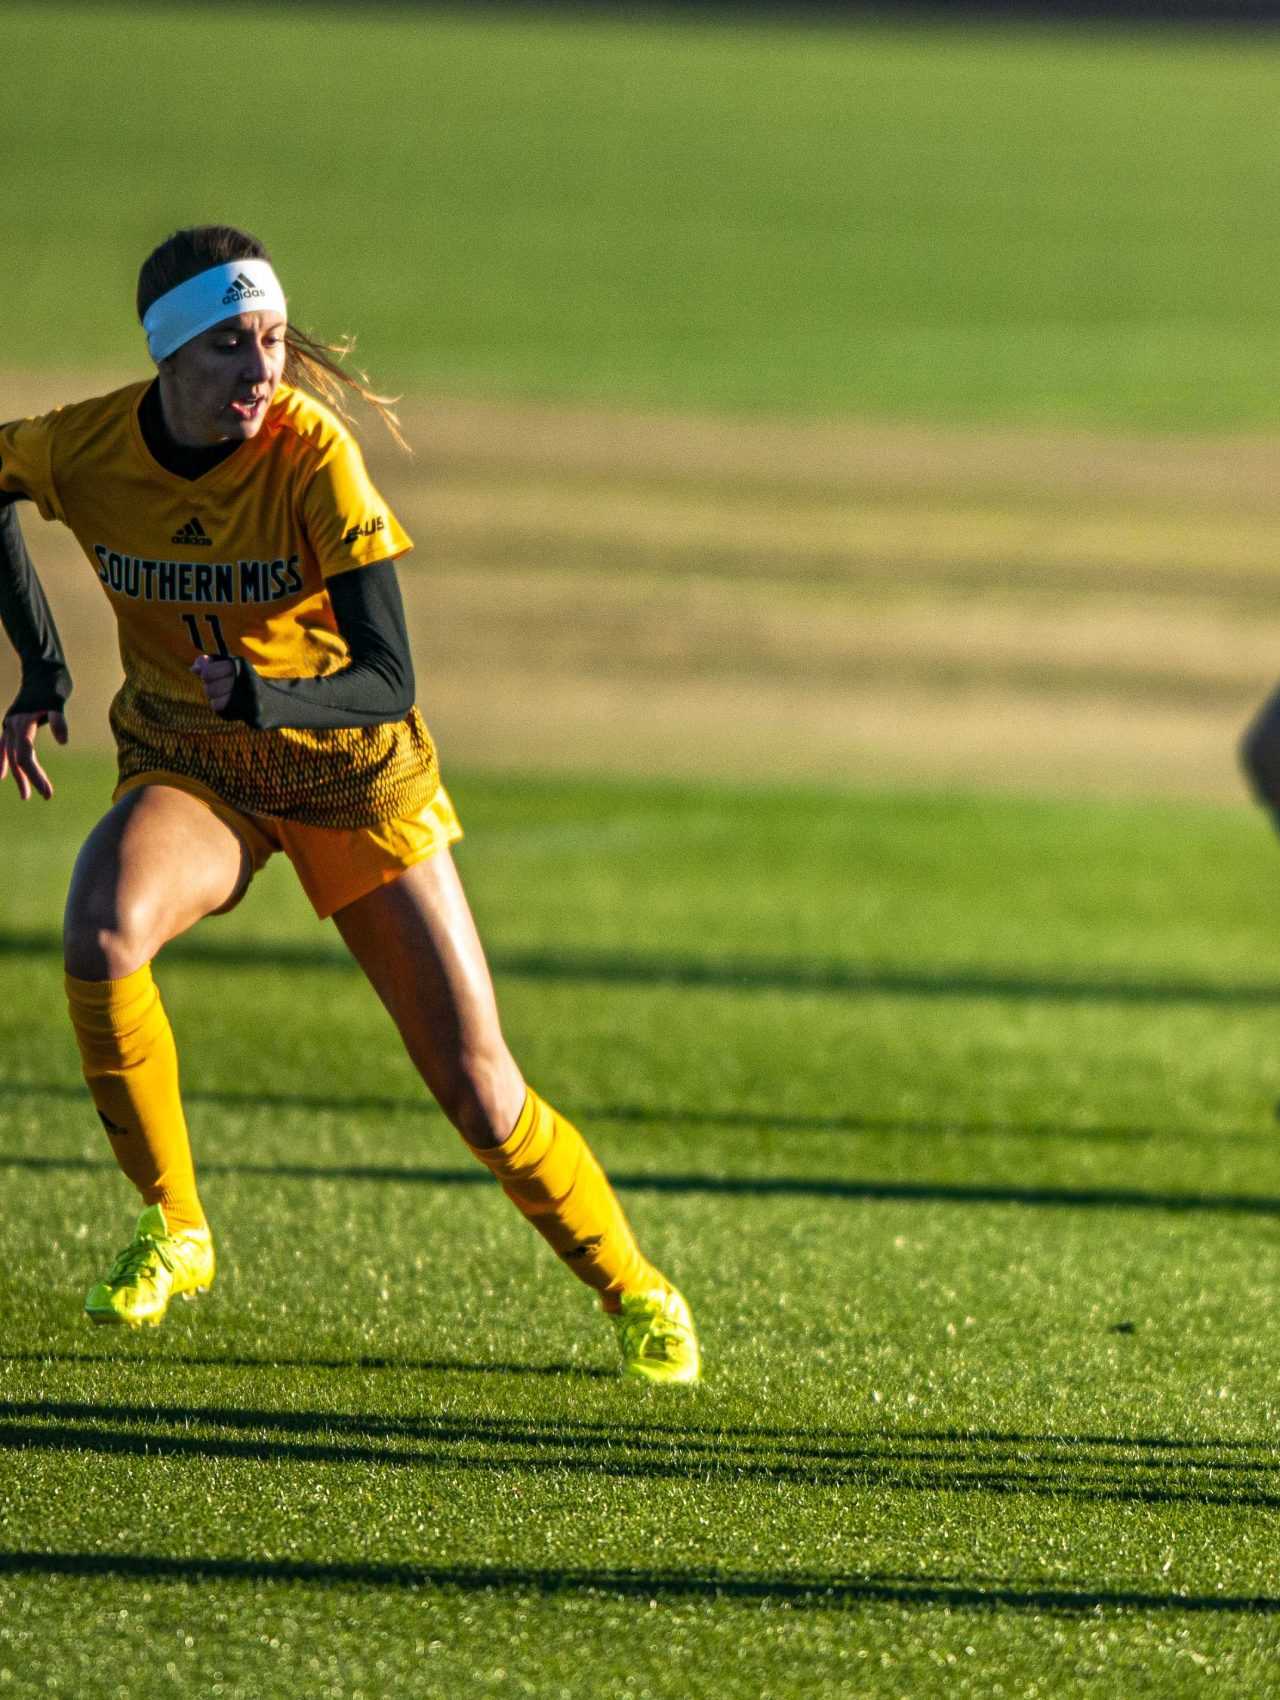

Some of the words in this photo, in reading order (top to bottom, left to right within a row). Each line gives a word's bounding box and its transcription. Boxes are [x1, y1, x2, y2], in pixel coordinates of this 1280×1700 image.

[222, 288, 266, 305] adidas
[93, 544, 234, 603] SOUTHERN
[237, 555, 304, 604] MISS
[180, 613, 230, 657] 11
